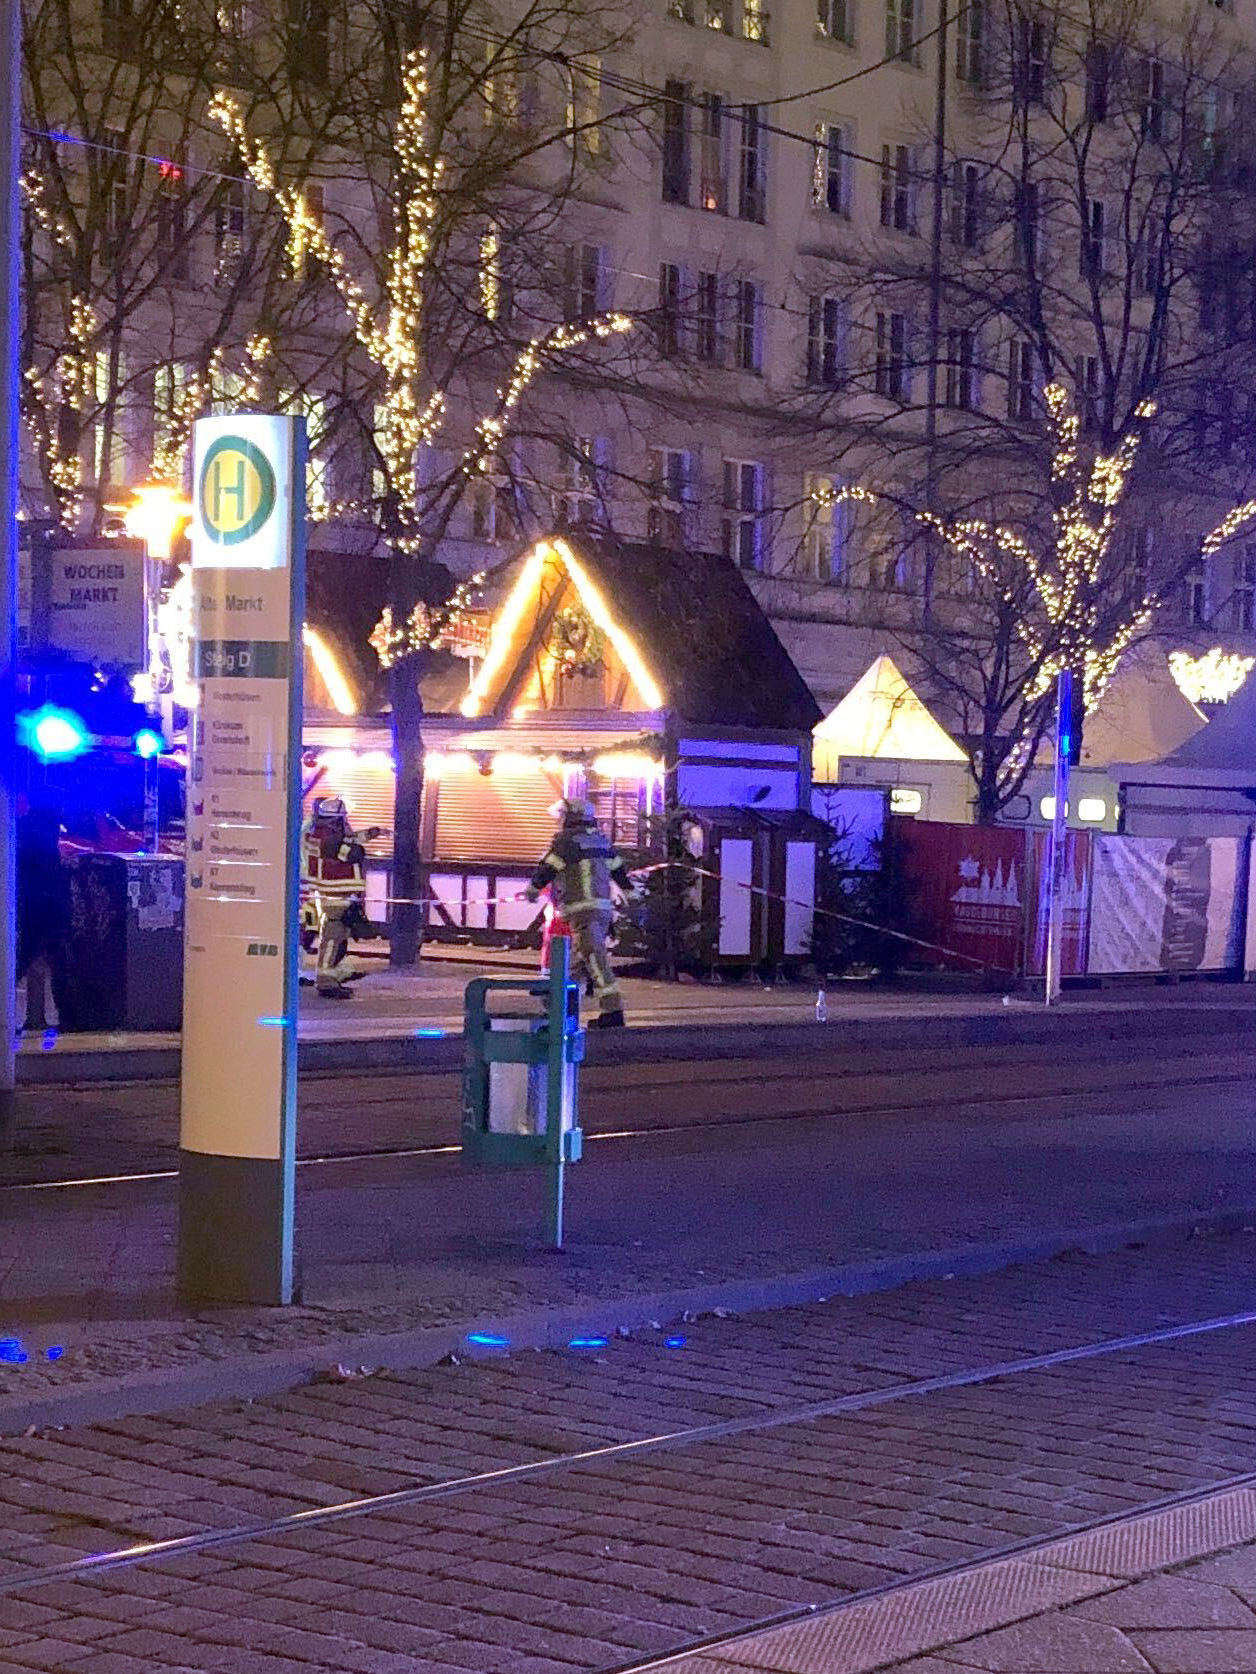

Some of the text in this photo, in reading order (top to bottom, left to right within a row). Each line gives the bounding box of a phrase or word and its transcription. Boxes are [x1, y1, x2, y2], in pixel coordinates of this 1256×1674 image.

[213, 461, 245, 521] H
[64, 563, 125, 580] WOCHEN
[70, 586, 119, 602] MARKT
[225, 594, 263, 612] Markt
[239, 651, 251, 668] D
